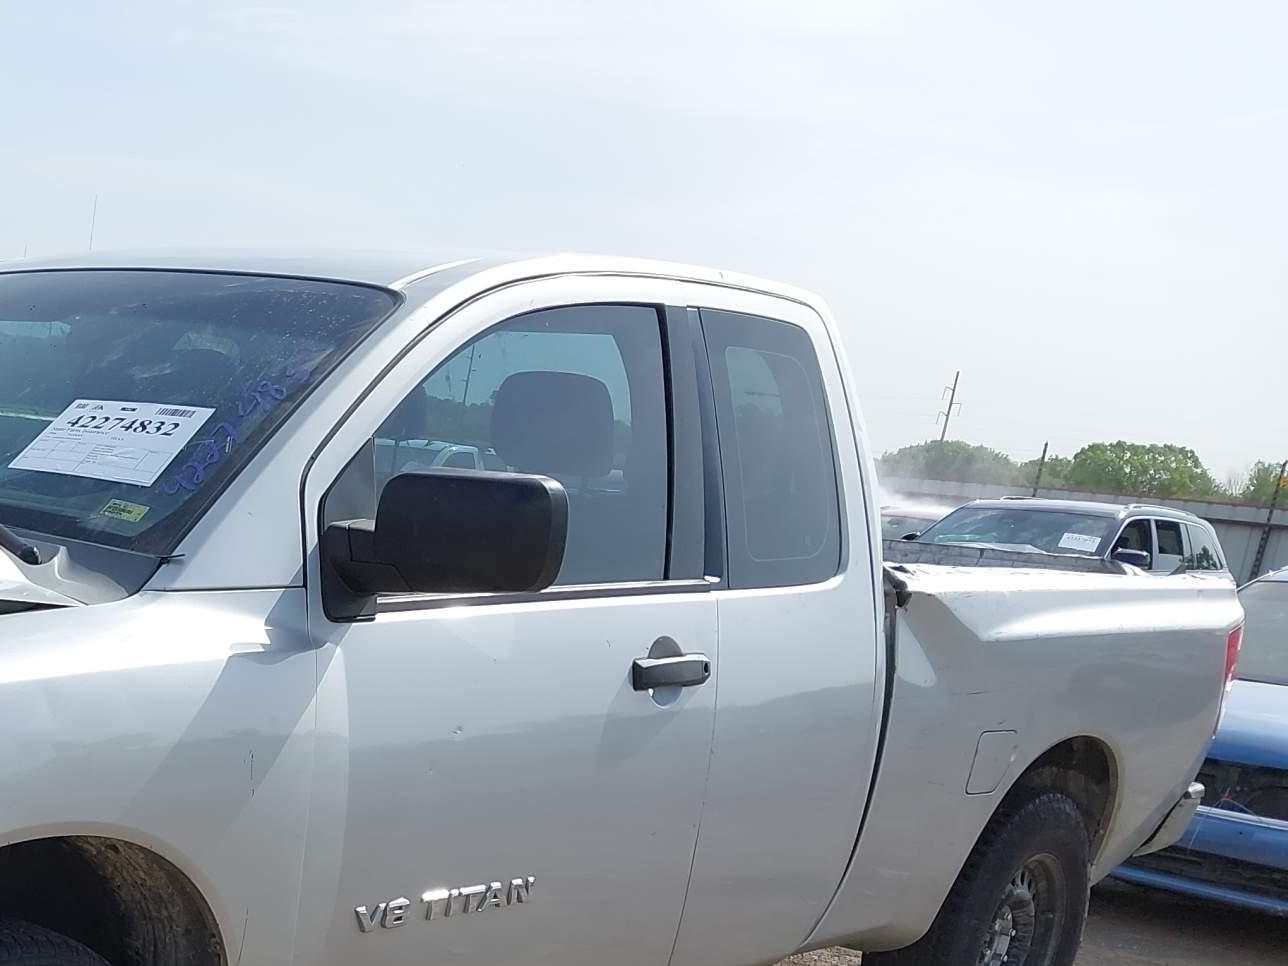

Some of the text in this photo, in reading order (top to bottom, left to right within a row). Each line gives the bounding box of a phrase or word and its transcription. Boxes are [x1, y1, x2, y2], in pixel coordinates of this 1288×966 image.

[66, 414, 181, 437] 42274832
[354, 874, 535, 933] V8 TITAN
